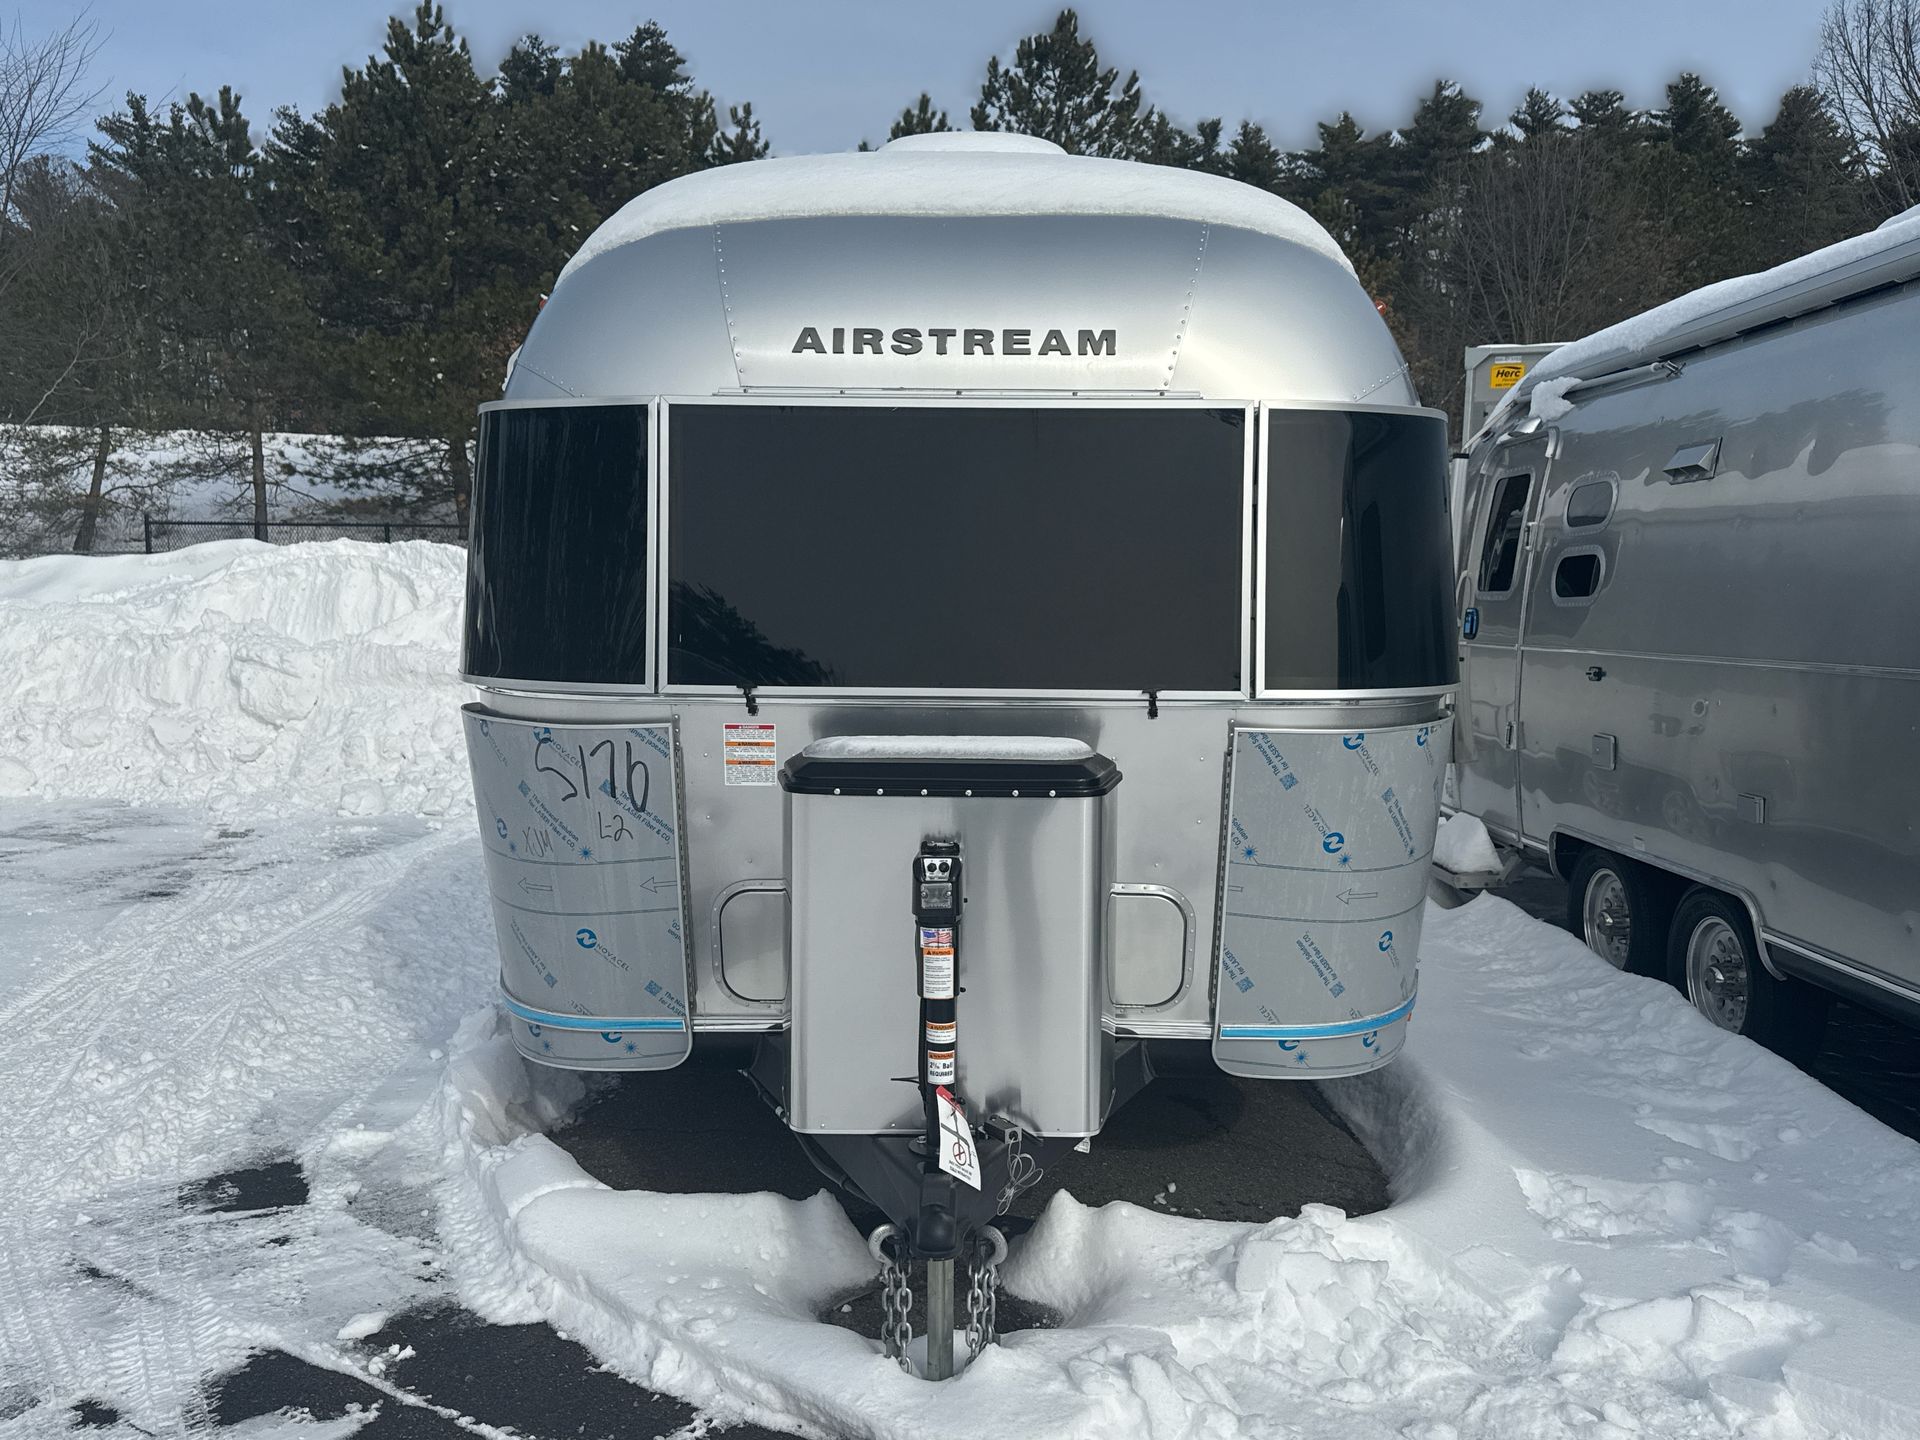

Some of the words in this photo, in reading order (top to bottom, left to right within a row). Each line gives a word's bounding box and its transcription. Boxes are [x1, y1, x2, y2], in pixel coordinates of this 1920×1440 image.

[792, 327, 1117, 355] AIRSTREAM
[1496, 369, 1521, 378] Herc
[1255, 743, 1274, 766] Novacel
[1267, 742, 1284, 762] LASER
[1359, 744, 1381, 776] NOVACEL
[1269, 764, 1281, 776] The
[1280, 761, 1289, 770] for
[619, 790, 631, 802] The
[533, 807, 551, 825] LASER
[549, 822, 563, 837] Fiber
[613, 797, 624, 807] for
[622, 804, 643, 821] LASER
[641, 818, 657, 831] Fiber
[1301, 804, 1329, 838] NOVACEL
[558, 821, 580, 843] Solution
[596, 943, 630, 971] NOVACEL
[1224, 950, 1240, 968] LASER
[1295, 939, 1313, 960] Solution
[1310, 945, 1324, 960] Fiber
[1227, 969, 1238, 980] The
[1236, 966, 1246, 976] for
[1308, 958, 1326, 979] Novacel
[1319, 957, 1334, 974] LASER
[658, 996, 668, 1006] for
[664, 991, 676, 1001] The
